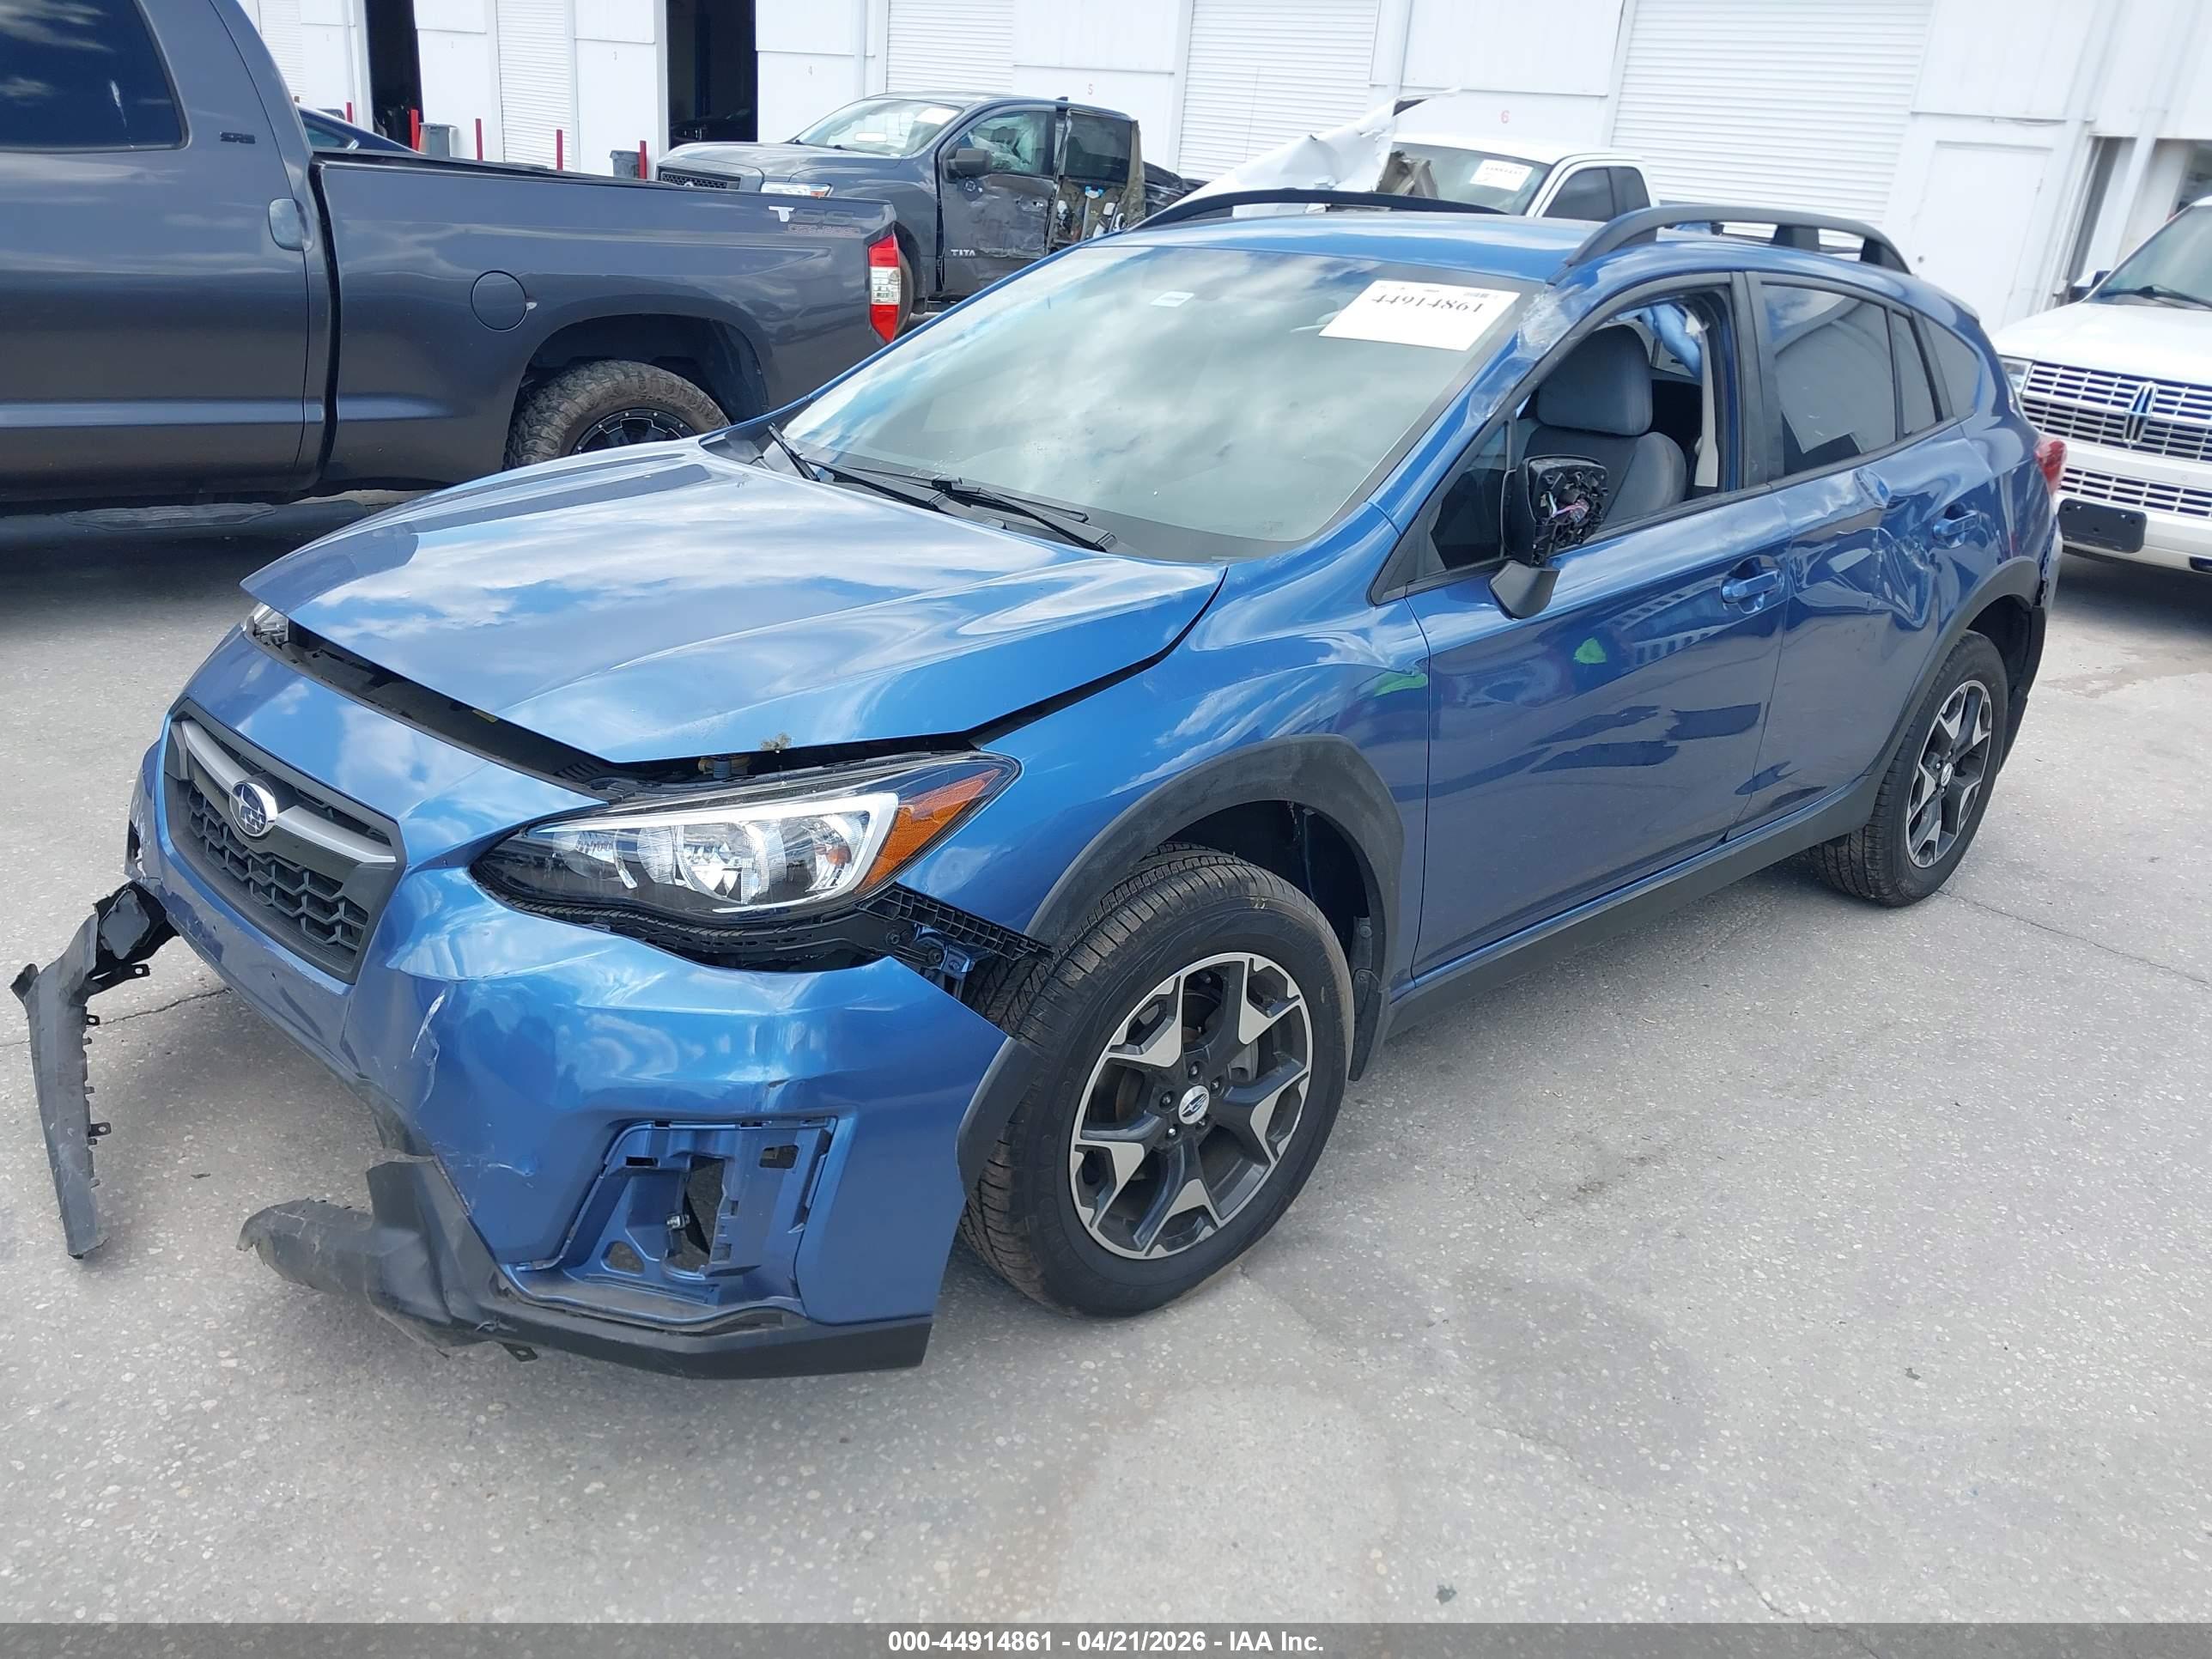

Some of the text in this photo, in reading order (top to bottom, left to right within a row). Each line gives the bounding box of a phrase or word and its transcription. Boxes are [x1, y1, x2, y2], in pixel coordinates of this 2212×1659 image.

[807, 64, 813, 76] 4
[1087, 82, 1094, 96] 5
[1500, 109, 1510, 125] 6
[1371, 294, 1485, 313] 44914861
